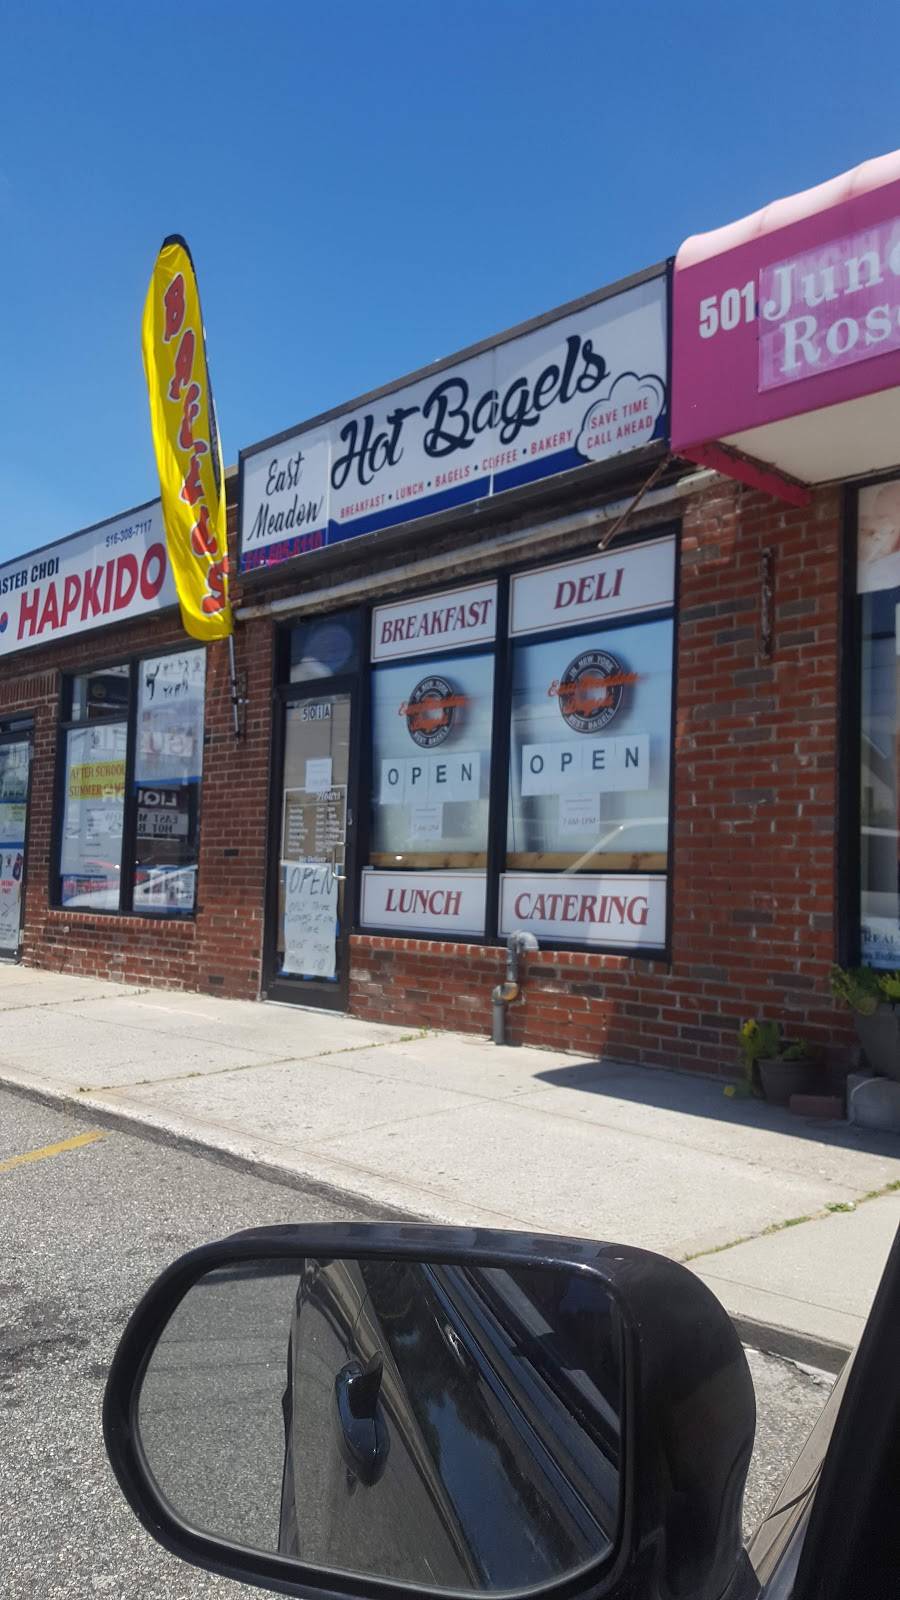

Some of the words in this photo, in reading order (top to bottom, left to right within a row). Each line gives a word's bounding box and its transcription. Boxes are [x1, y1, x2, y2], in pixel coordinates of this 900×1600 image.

[699, 281, 755, 339] 501
[331, 406, 420, 490] Hot
[422, 335, 611, 458] Bagels
[591, 409, 618, 430] SAVE
[622, 396, 649, 418] TIME
[586, 430, 612, 450] CALL
[616, 415, 653, 440] AHEAD
[265, 450, 304, 497] East
[340, 493, 385, 519] BREAKFAST
[395, 482, 424, 501] LUNCH
[435, 465, 471, 487] BAGELS
[482, 448, 518, 472] COFFEE
[530, 429, 573, 455] BAKERY
[246, 493, 325, 541] Meadow
[30, 556, 60, 584] CHOI
[16, 542, 167, 641] HAPKIDO
[552, 567, 626, 611] DELI
[379, 598, 494, 646] BREAKFAST
[302, 704, 332, 721] 501A
[387, 762, 473, 786] OPEN
[529, 746, 640, 775] OPEN
[288, 866, 335, 896] OPEN
[384, 888, 463, 916] LUNCH
[513, 892, 650, 926] CATERING
